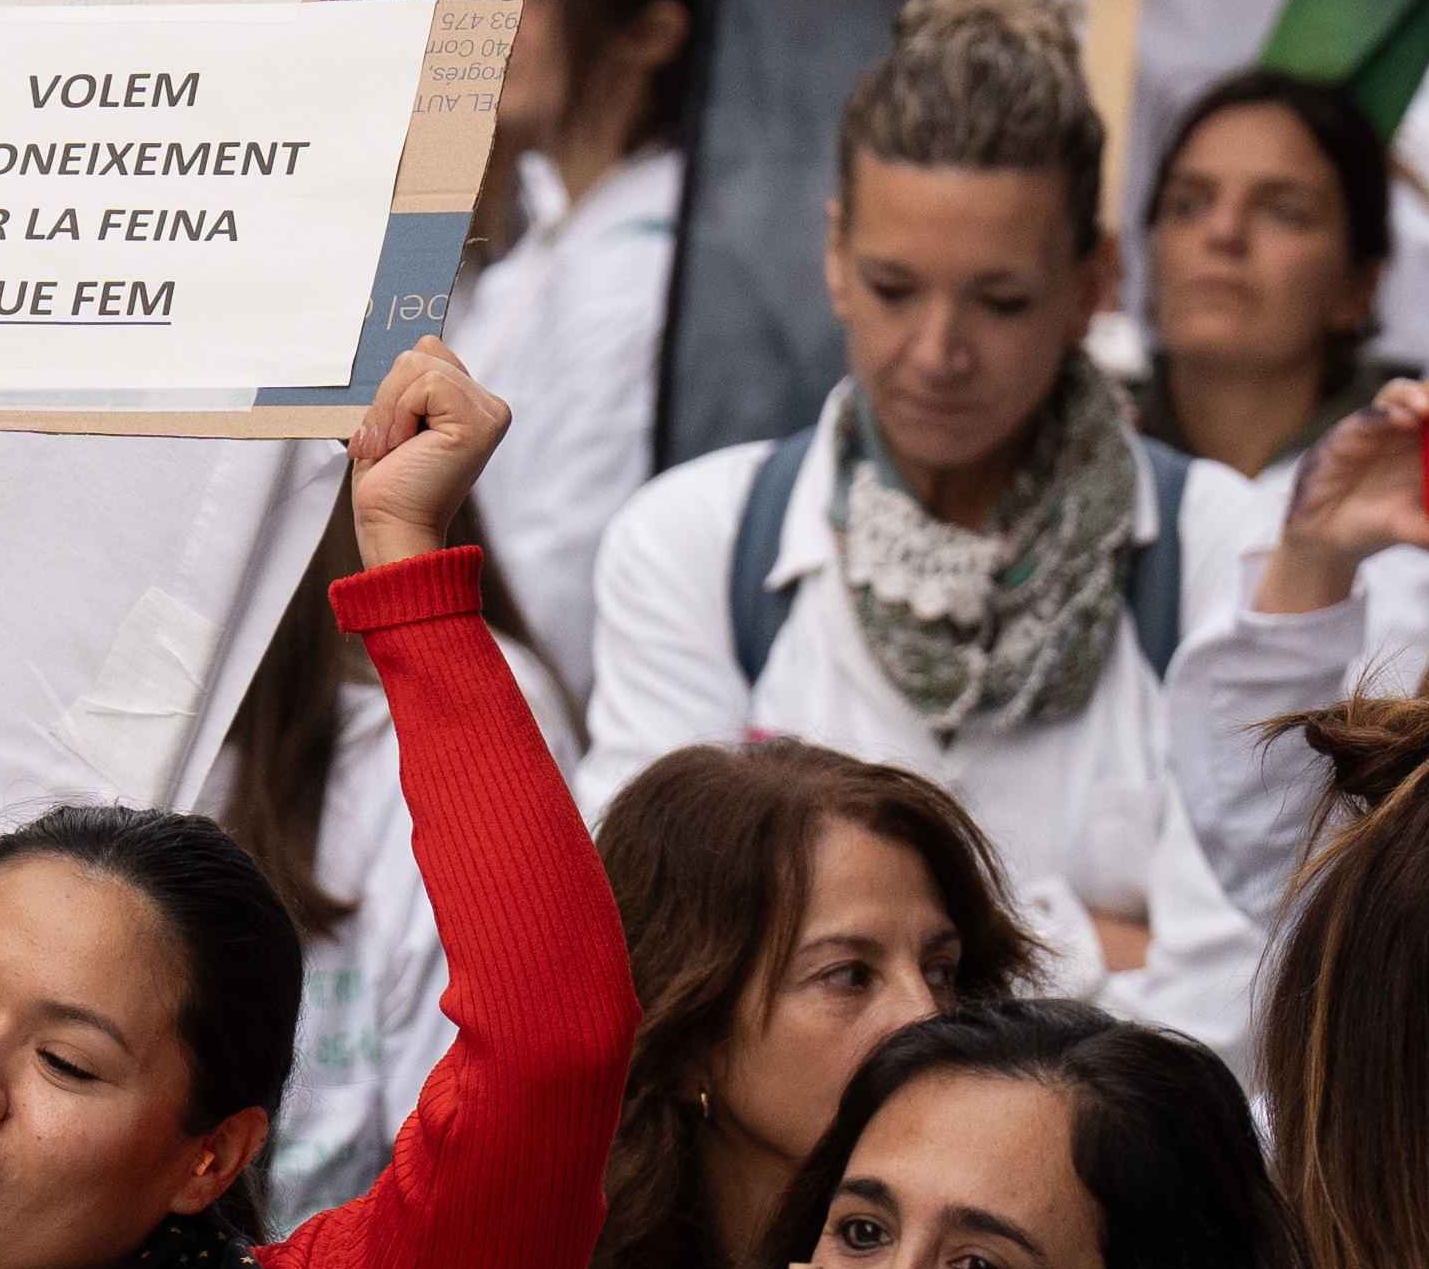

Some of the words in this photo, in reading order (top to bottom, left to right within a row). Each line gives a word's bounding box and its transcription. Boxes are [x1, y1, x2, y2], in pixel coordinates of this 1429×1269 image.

[441, 12, 484, 31] 475
[491, 11, 519, 30] 93
[28, 72, 201, 109] VOLEM
[25, 208, 81, 241] LA
[98, 209, 239, 242] FEINA
[71, 281, 177, 317] FEM
